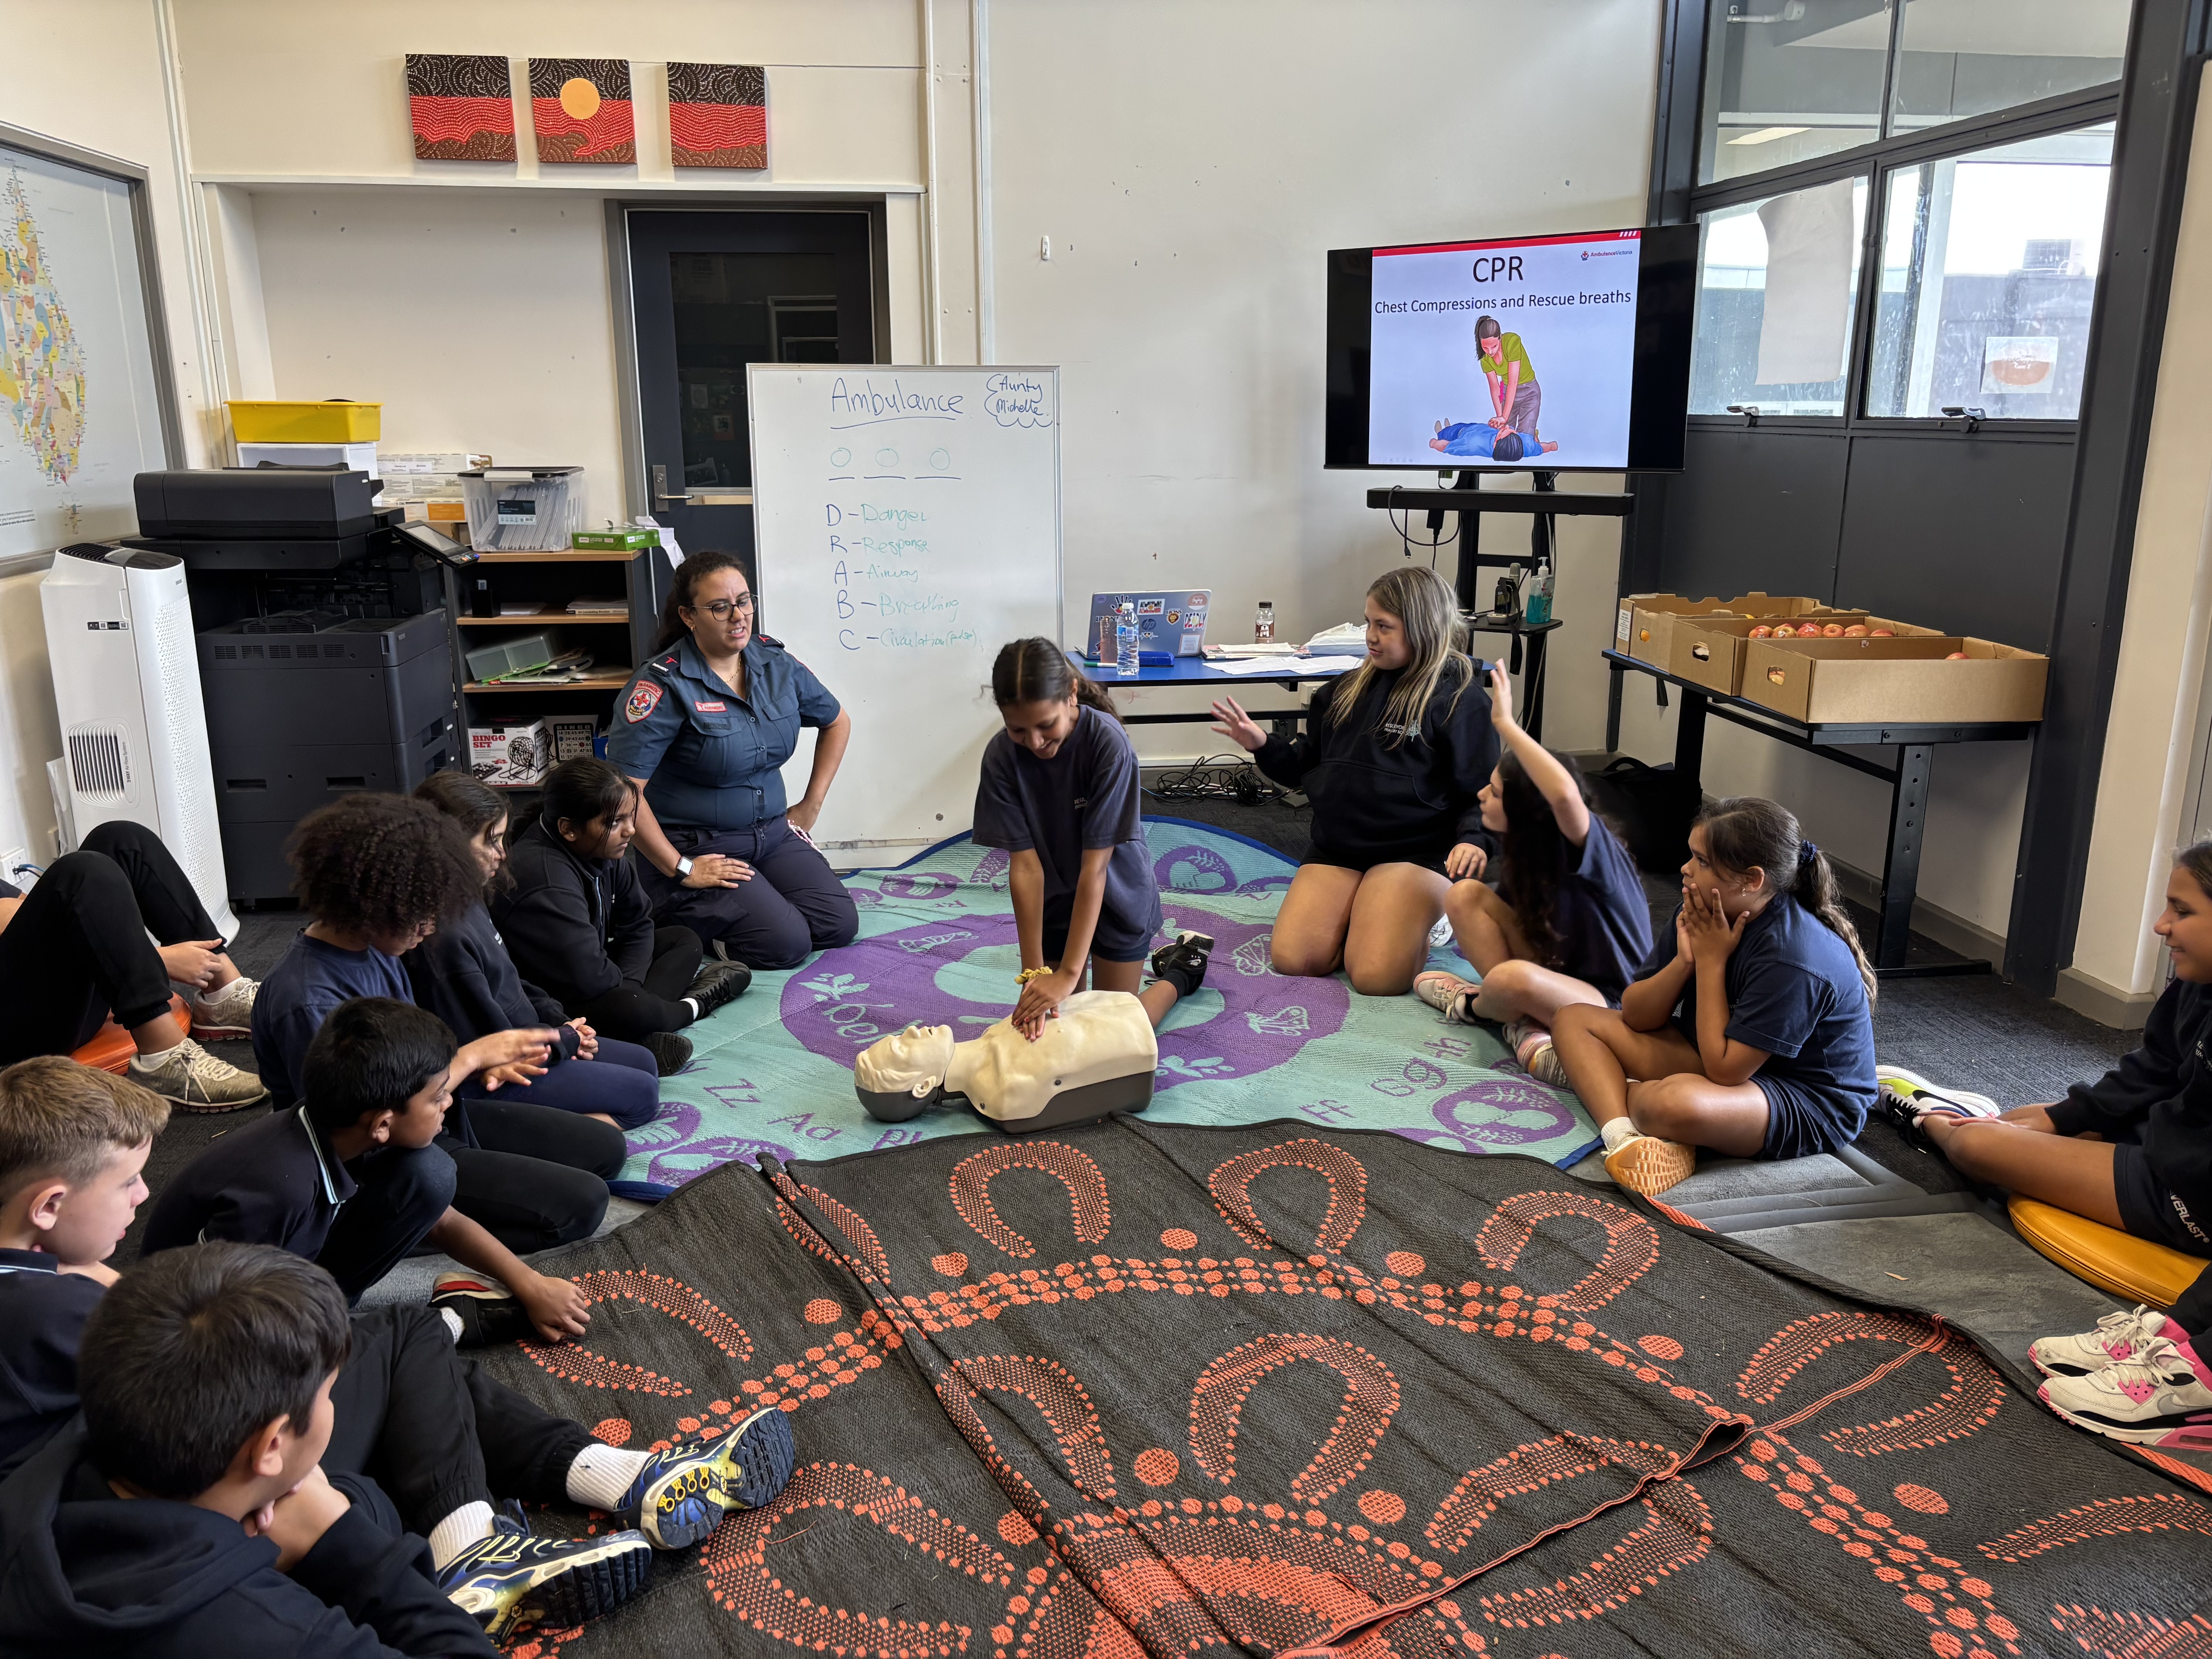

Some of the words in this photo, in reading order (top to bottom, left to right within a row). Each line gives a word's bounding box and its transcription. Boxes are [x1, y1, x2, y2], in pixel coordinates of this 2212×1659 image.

[1472, 255, 1524, 283] CPR
[1375, 300, 1407, 314] Chest
[1411, 296, 1497, 314] Compressions
[1501, 293, 1524, 308] and
[1529, 292, 1575, 307] Rescue
[1579, 289, 1631, 305] breaths
[832, 378, 963, 416] Ambulance
[1000, 375, 1042, 403] Aunty
[996, 398, 1044, 416] Michelle
[826, 504, 841, 526] D
[861, 504, 928, 531] Danger
[831, 536, 847, 553] R
[862, 537, 931, 557] Response
[835, 561, 847, 586] A
[866, 564, 918, 582] Airway
[838, 589, 854, 619] B
[879, 593, 959, 622] Breathing
[1143, 619, 1155, 630] hp
[839, 629, 860, 650] C
[638, 683, 661, 694] PARAMEDIC
[767, 1112, 843, 1141] Aa
